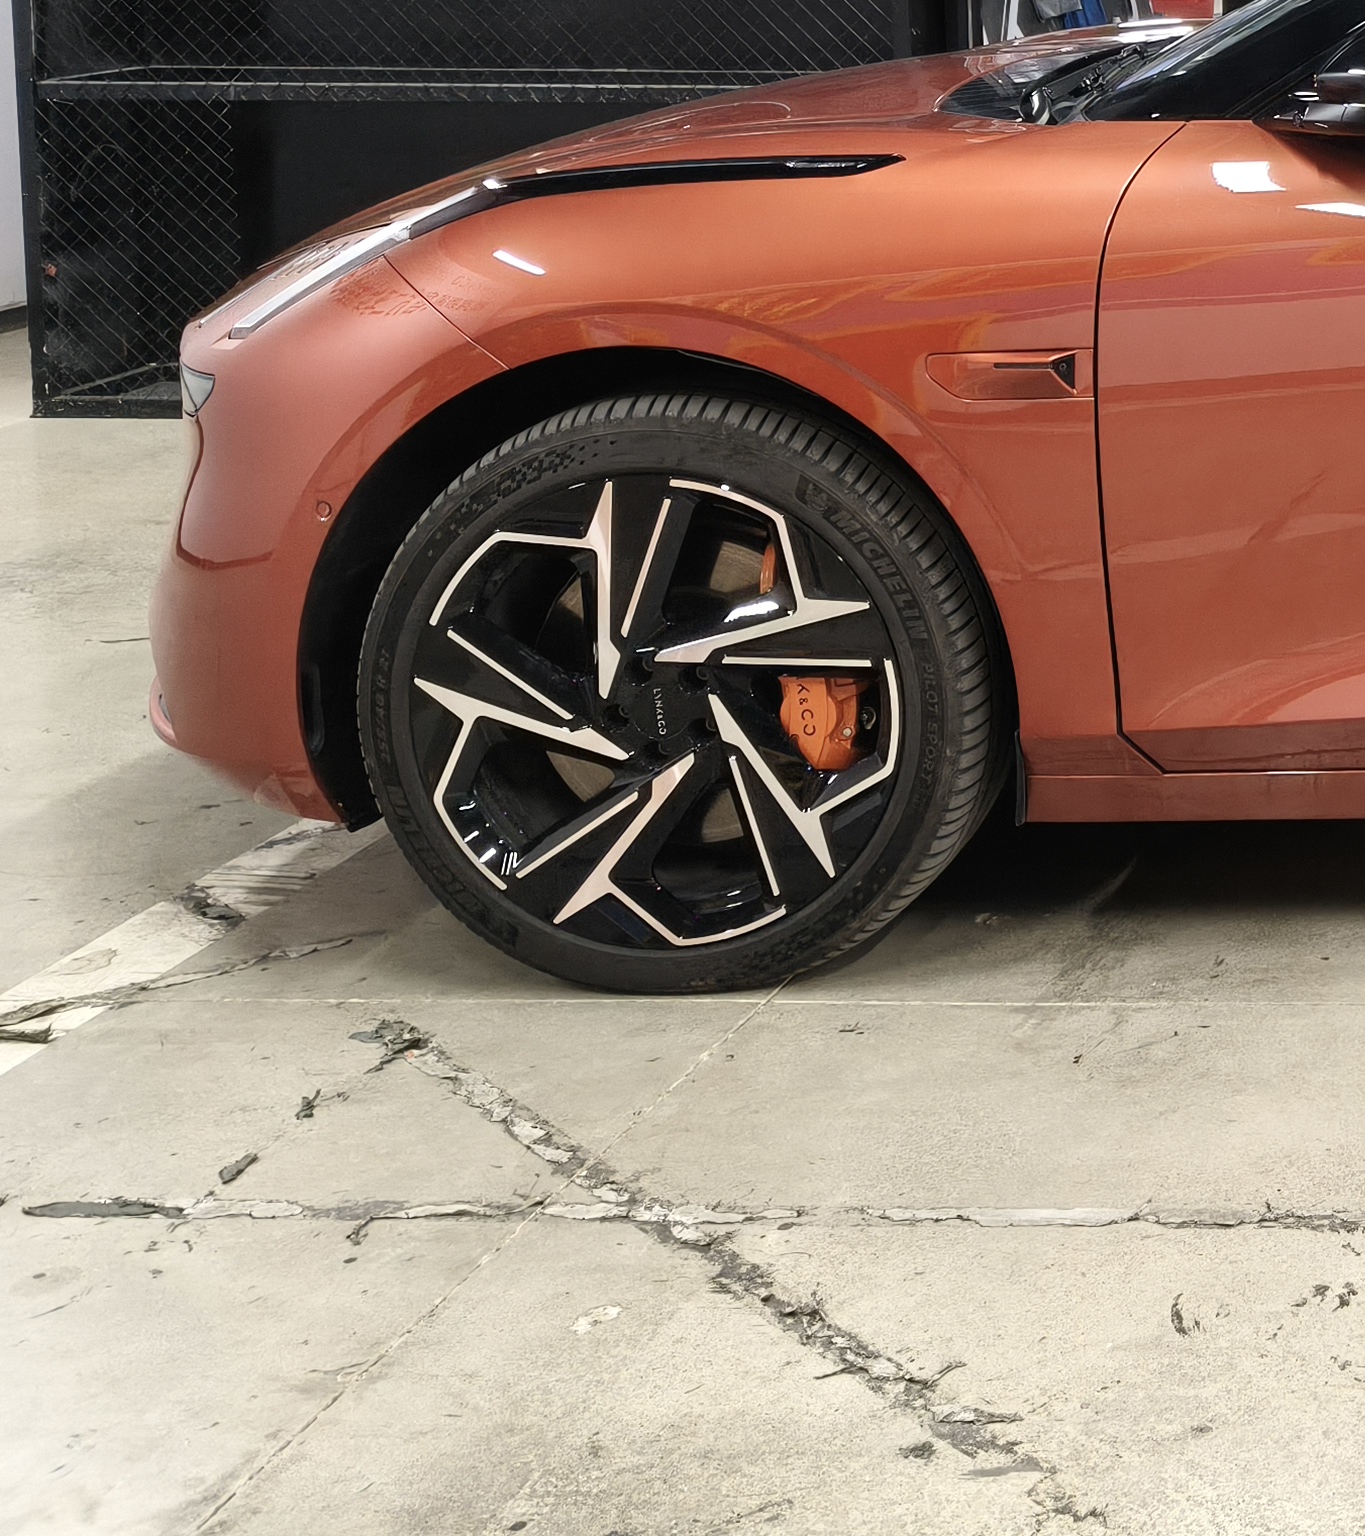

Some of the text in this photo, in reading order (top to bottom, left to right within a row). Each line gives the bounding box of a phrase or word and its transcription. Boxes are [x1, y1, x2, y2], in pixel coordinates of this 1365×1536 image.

[832, 513, 929, 640] MICHELIN
[920, 663, 940, 786] PILOT SPORT
